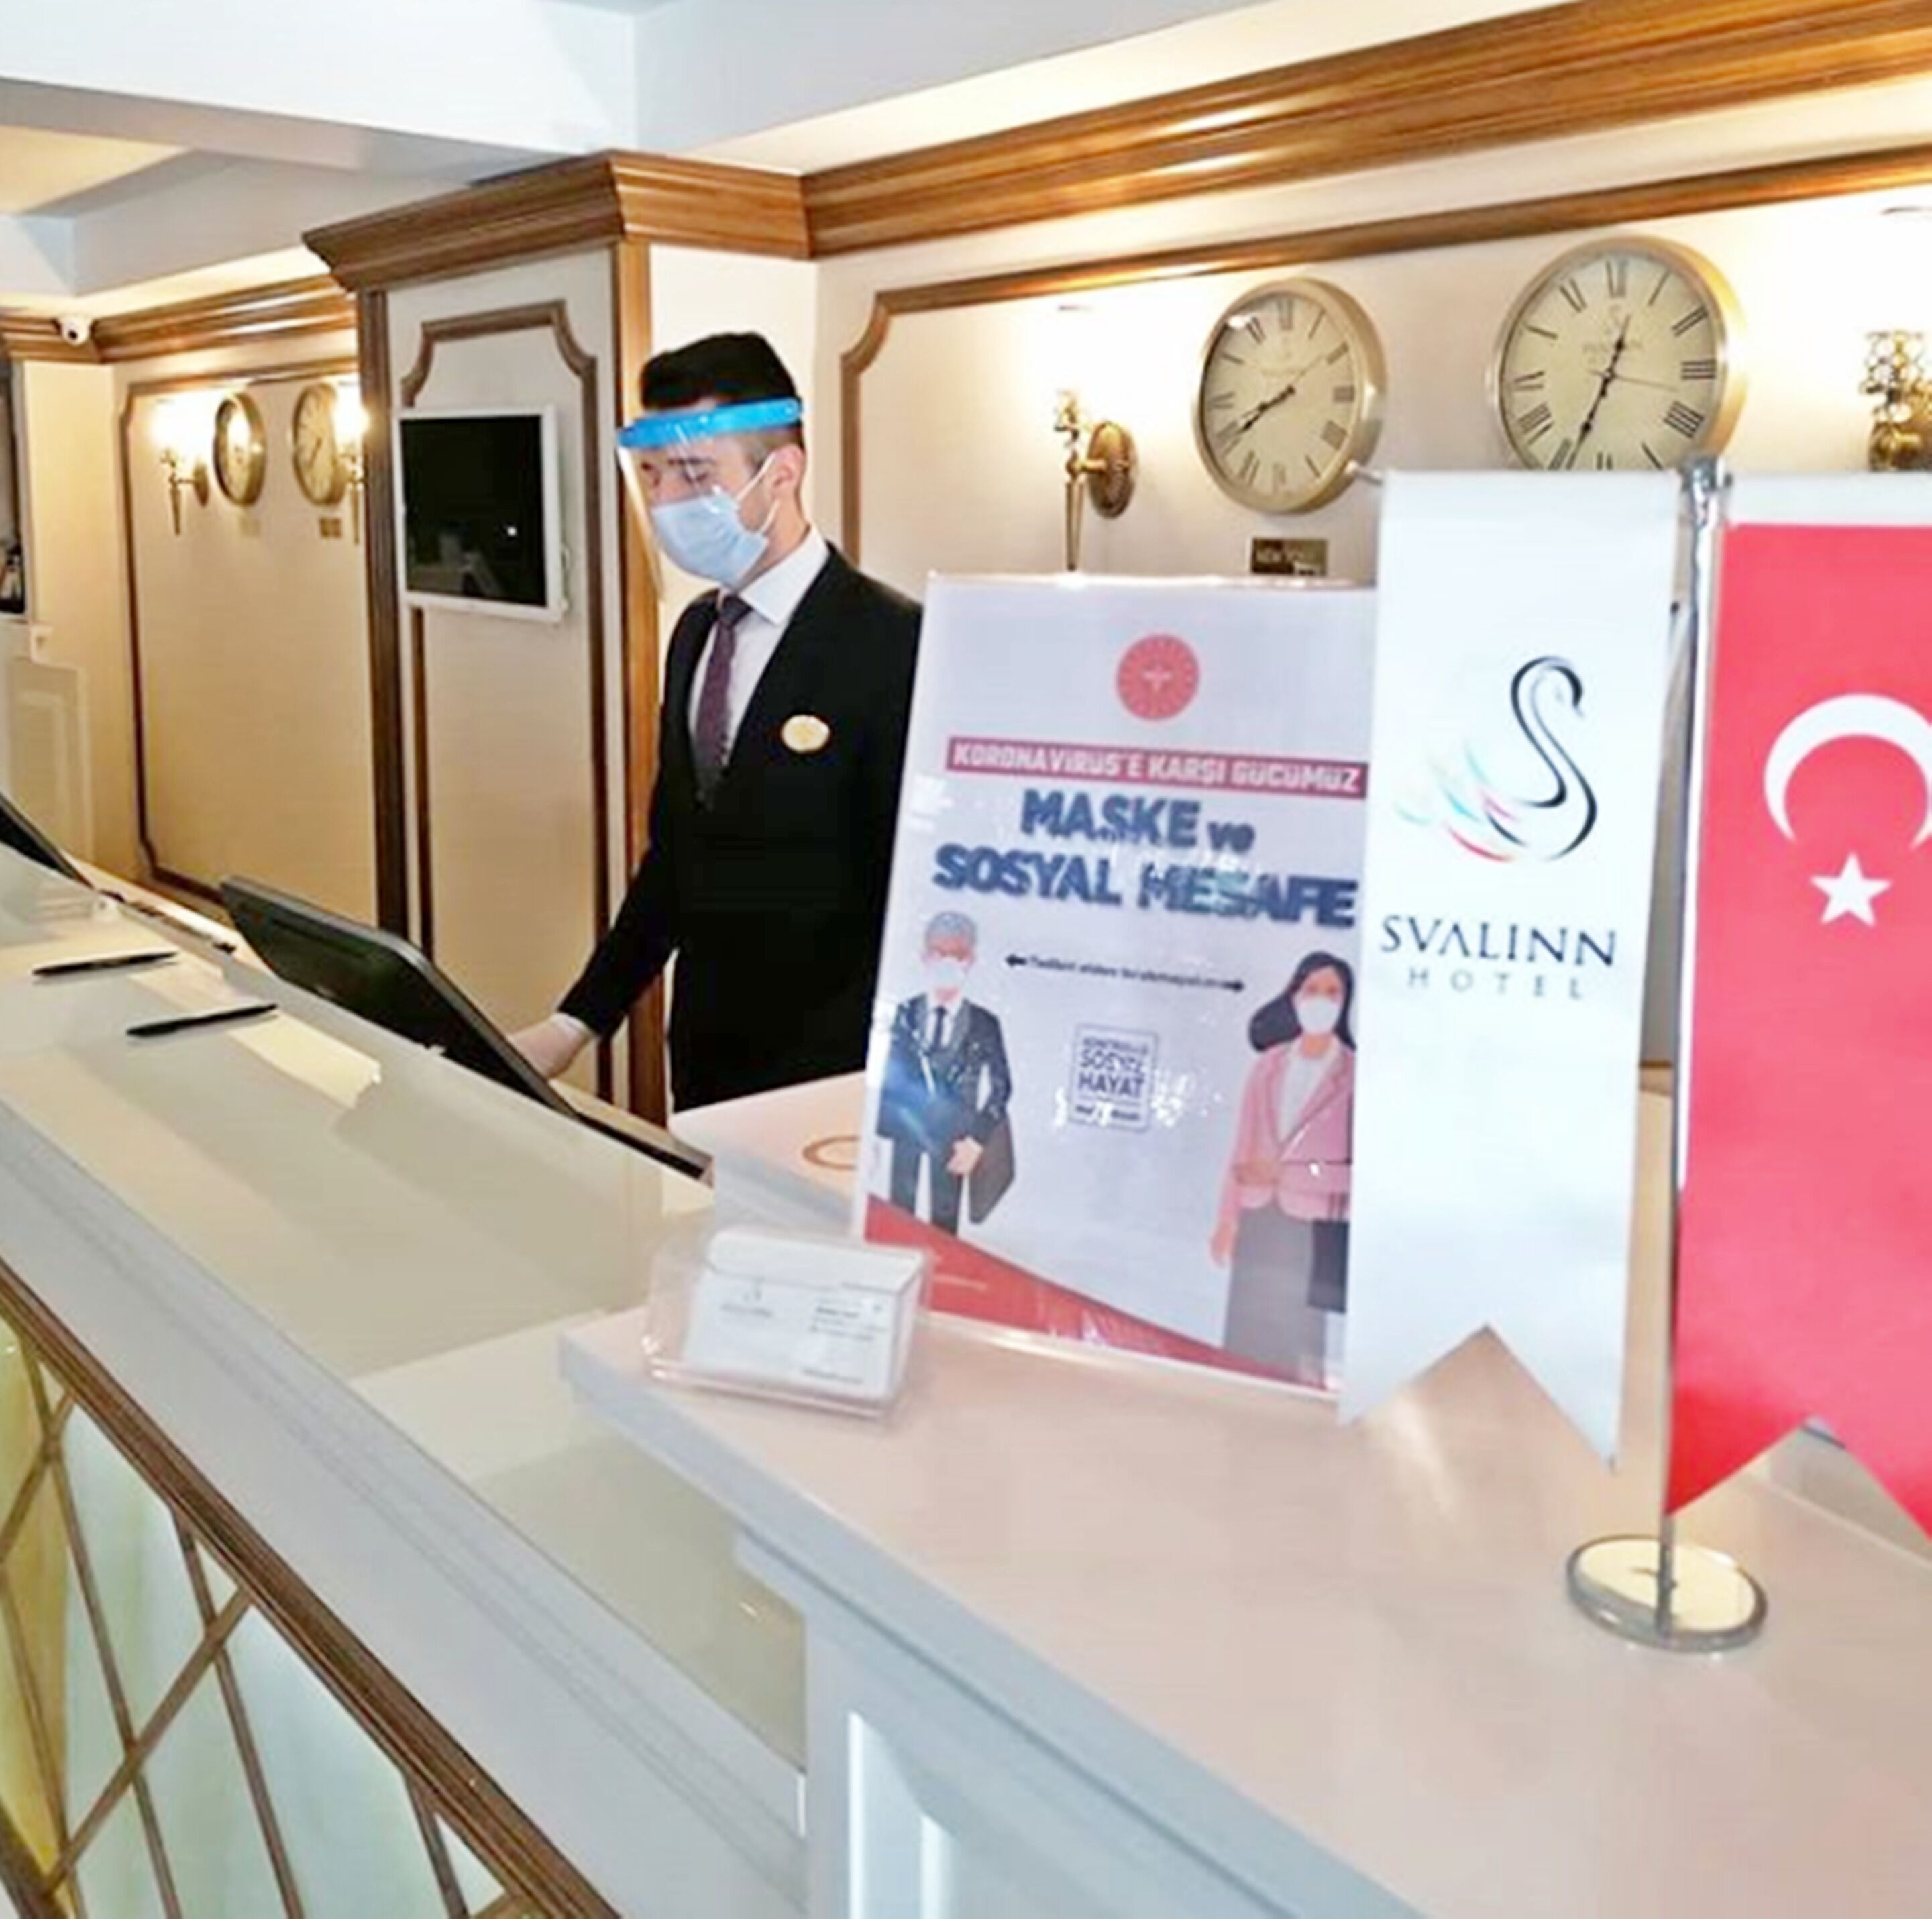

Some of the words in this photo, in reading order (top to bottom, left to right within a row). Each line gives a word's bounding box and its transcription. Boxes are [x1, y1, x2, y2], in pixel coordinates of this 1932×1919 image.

[1020, 788, 1200, 849] MASKE
[1207, 821, 1255, 854] ve
[932, 843, 1122, 906] SOSYAL
[1138, 862, 1358, 928] MESAFE
[1381, 914, 1617, 967] SVALINN
[1409, 966, 1583, 1000] HOTEL
[1077, 1071, 1145, 1099] HAYAT
